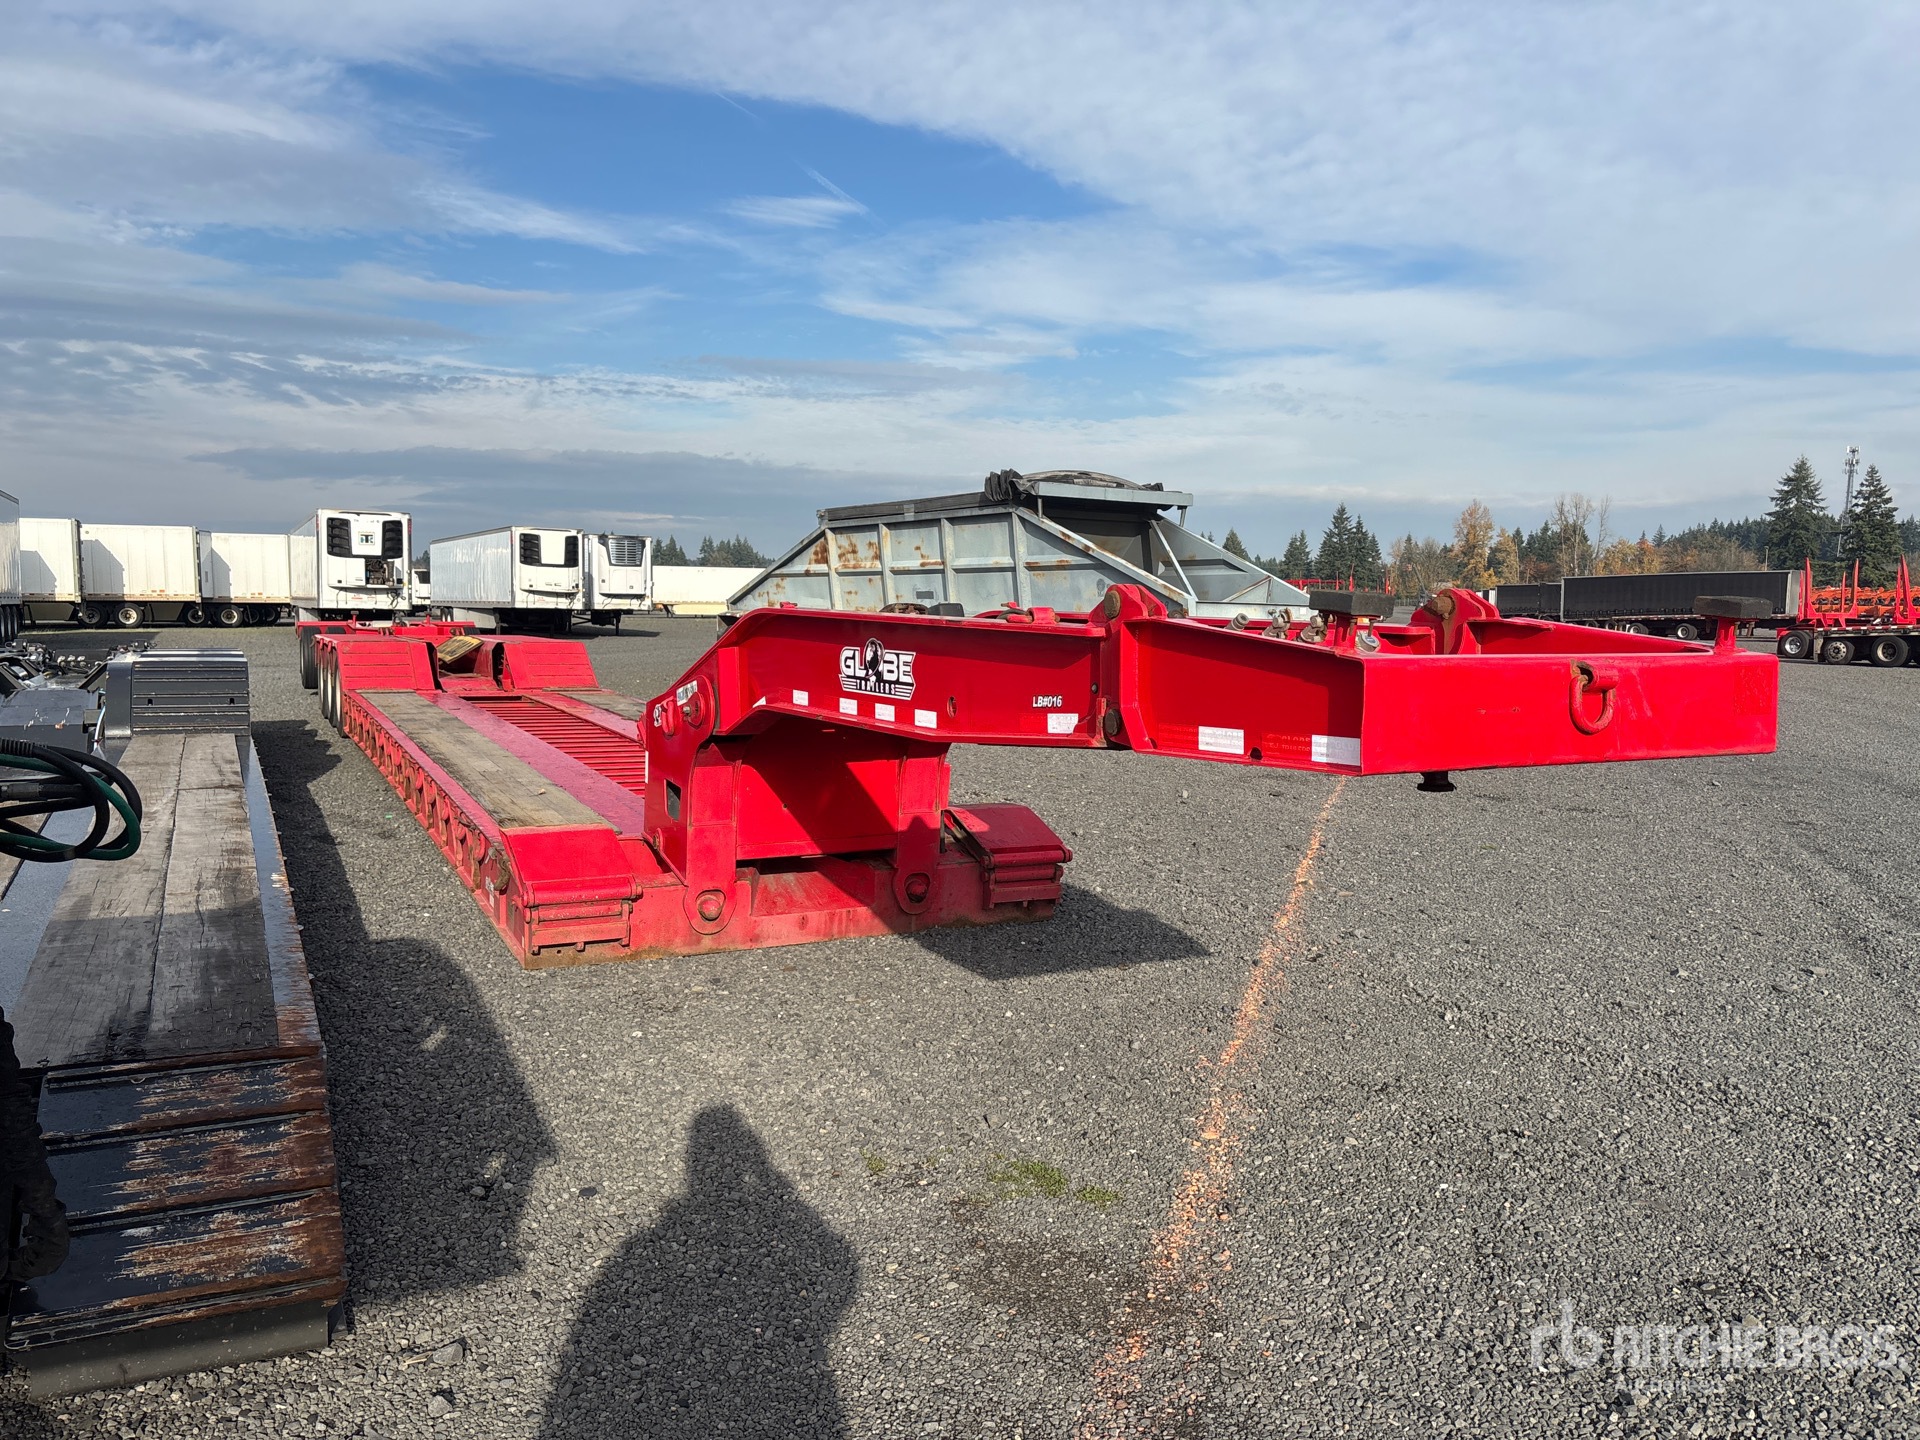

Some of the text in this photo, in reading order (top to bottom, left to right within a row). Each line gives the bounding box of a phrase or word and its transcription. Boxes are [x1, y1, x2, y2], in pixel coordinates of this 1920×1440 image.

[840, 639, 914, 684] GLOBE
[856, 679, 896, 695] TRAILERS
[1032, 695, 1063, 708] LB#016
